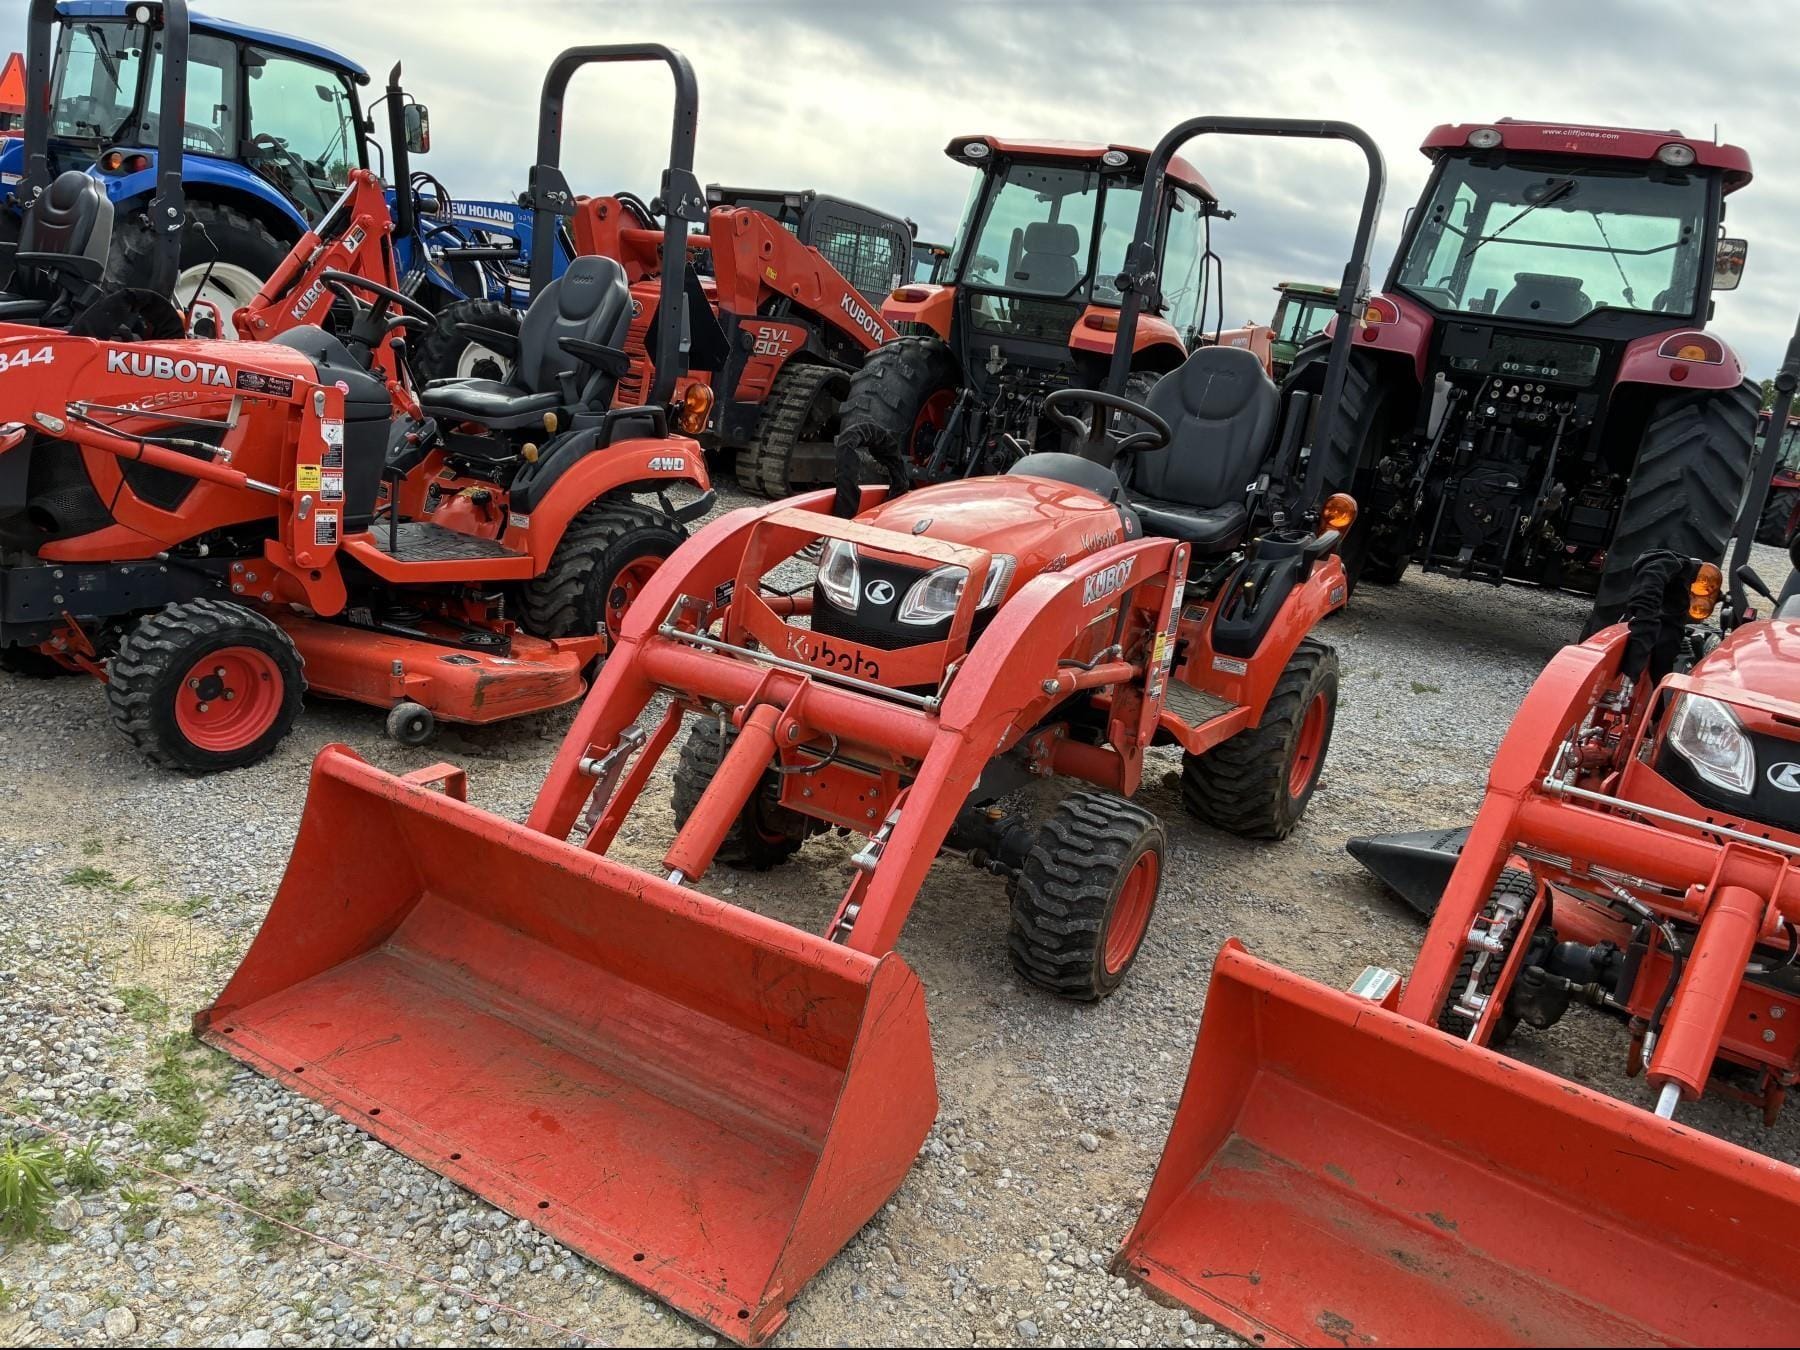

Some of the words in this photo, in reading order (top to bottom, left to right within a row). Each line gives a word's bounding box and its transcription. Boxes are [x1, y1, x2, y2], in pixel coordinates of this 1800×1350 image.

[1542, 129, 1620, 140] www.cliffjones.com
[468, 204, 514, 223] HOLLAND
[840, 292, 886, 346] KUBOTA
[758, 326, 793, 343] SVL
[107, 349, 234, 388] KUBOTA
[647, 456, 685, 471] 4WD
[786, 631, 880, 680] Kubota
